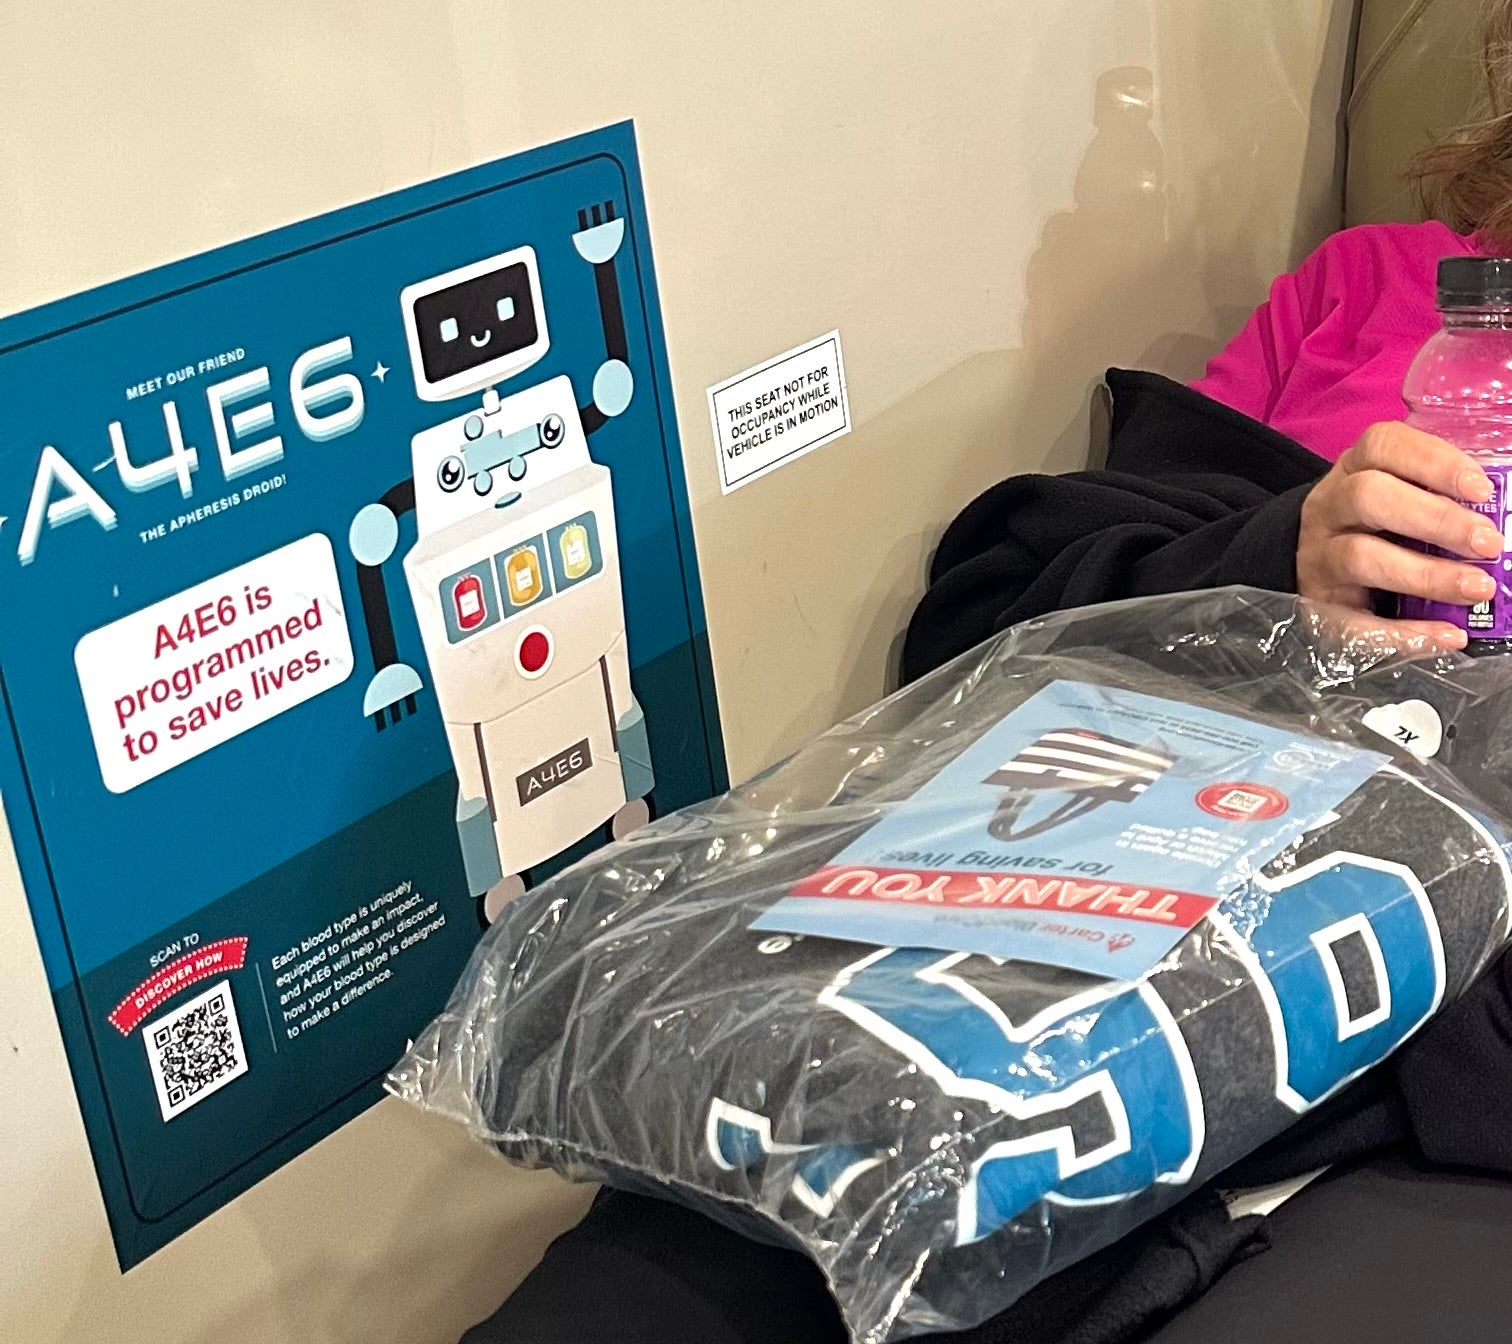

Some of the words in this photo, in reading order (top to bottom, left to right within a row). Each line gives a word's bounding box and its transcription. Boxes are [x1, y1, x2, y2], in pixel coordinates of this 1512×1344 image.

[126, 377, 163, 400] MEET
[166, 367, 196, 386] OUR
[198, 348, 246, 374] FRIEND
[728, 403, 753, 422] THIS
[754, 387, 781, 410] SEAT
[783, 376, 805, 397] NOT
[807, 366, 829, 385] FOR
[726, 428, 772, 459] VEHICLE
[774, 422, 784, 437] IS
[786, 416, 797, 430] IN
[799, 396, 838, 424] MOTION
[731, 399, 795, 439] OCCUPANCY
[797, 382, 831, 406] WHILE
[17, 336, 366, 567] A4E6
[139, 524, 167, 544] THE
[169, 493, 241, 534] APHERESIS
[243, 473, 288, 501] DROID!
[154, 595, 237, 659] A4E6
[243, 585, 273, 615] is
[114, 598, 323, 729] programmed
[123, 729, 158, 762] to
[168, 688, 243, 740] save
[251, 649, 330, 700] lives.
[1394, 726, 1420, 744] XL
[526, 751, 583, 796] A4E6
[821, 869, 952, 903] YOU
[958, 850, 1075, 875] saving
[1079, 862, 1113, 878] for
[271, 947, 300, 970] Each
[301, 925, 332, 953] blood
[333, 913, 357, 933] type
[358, 907, 368, 918] is
[369, 880, 412, 912] uniquely
[958, 876, 1180, 922] THANK
[150, 941, 181, 967] SCAN
[183, 933, 200, 947] TO
[276, 949, 327, 987] equipped
[327, 943, 340, 956] to
[341, 924, 370, 948] make
[371, 916, 385, 929] an
[280, 986, 301, 1005] and
[303, 966, 332, 991] A4E6
[332, 954, 351, 972] will
[352, 940, 375, 962] help
[376, 928, 395, 949] you
[397, 902, 438, 933] discover
[283, 1002, 307, 1022] how
[308, 985, 332, 1009] your
[333, 965, 364, 991] blood
[365, 951, 388, 972] type
[389, 944, 399, 957] is
[400, 914, 446, 950] designed
[134, 964, 193, 1009] DISCOVER
[195, 951, 223, 971] HOW
[287, 1026, 299, 1039] to
[301, 1006, 331, 1030] make
[332, 1000, 340, 1011] a
